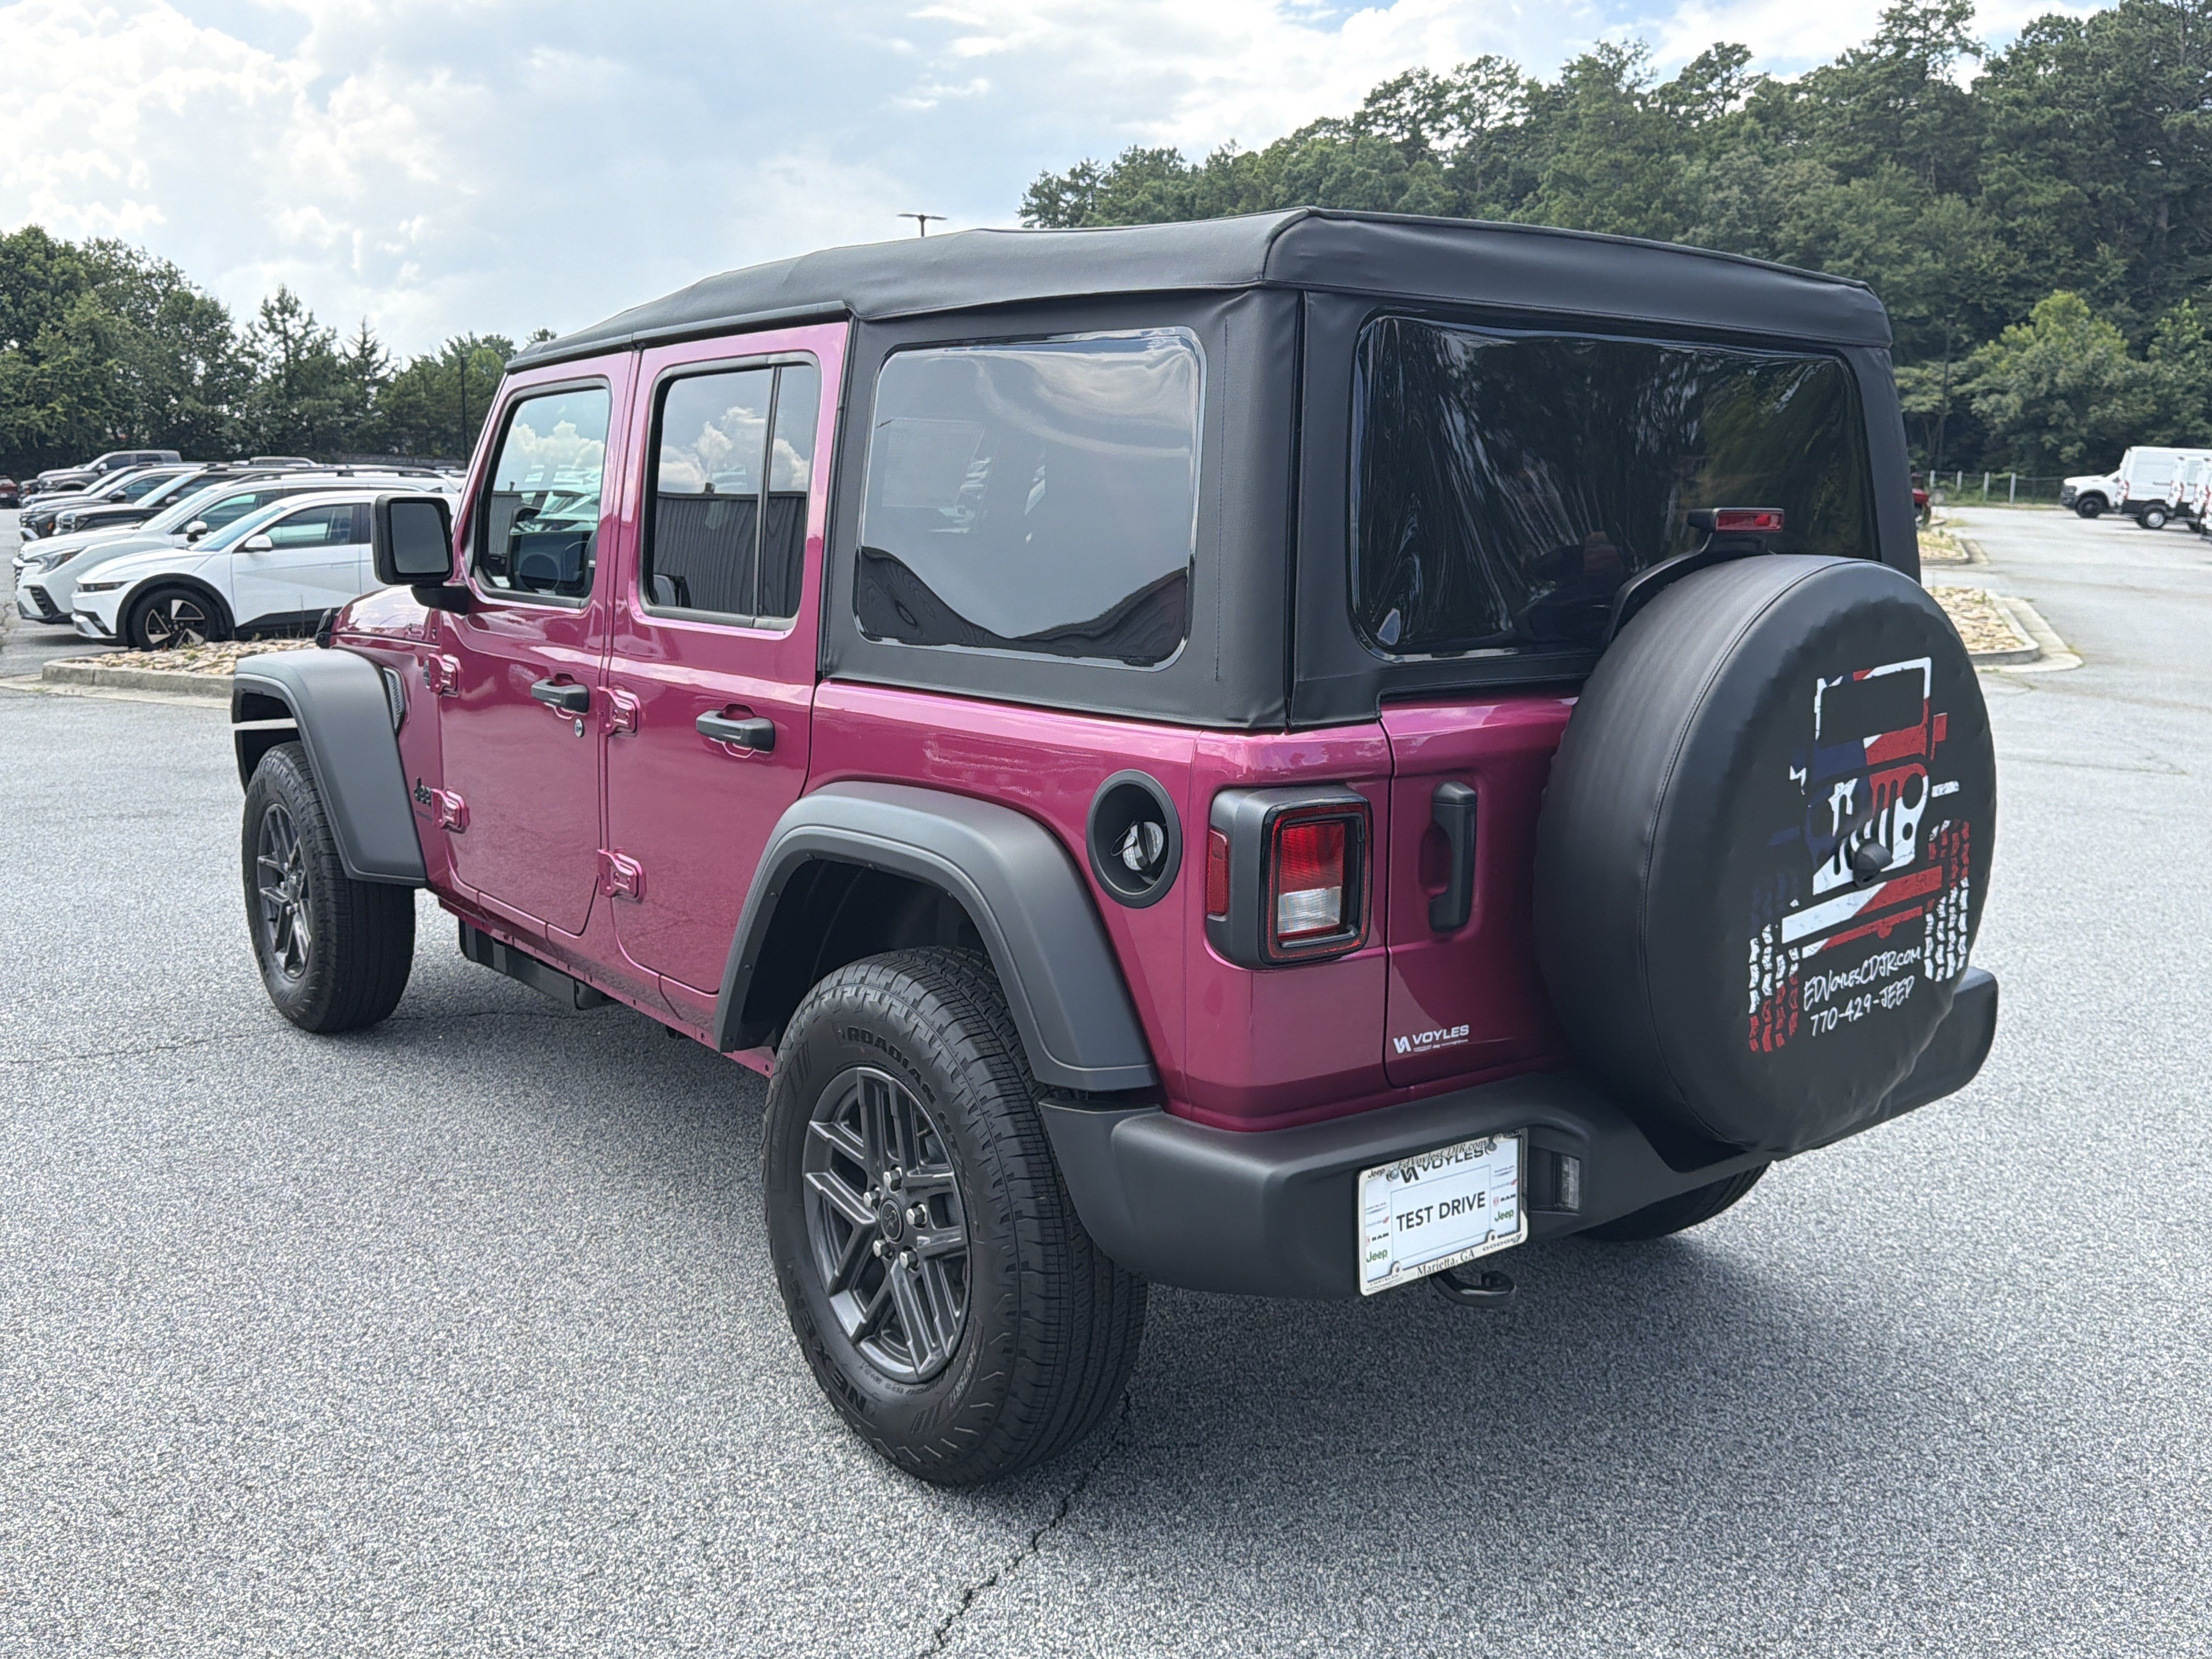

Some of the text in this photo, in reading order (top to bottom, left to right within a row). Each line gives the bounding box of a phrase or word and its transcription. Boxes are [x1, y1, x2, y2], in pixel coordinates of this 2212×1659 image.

[1810, 975, 1915, 1037] 770-429-JEEP
[1412, 1024, 1469, 1045] VOYLES
[1368, 1168, 1385, 1178] Jeep
[1396, 1191, 1486, 1232] TEST DRIVE
[1494, 1209, 1514, 1222] Jeep
[1366, 1249, 1388, 1263] Jeep
[1417, 1249, 1475, 1278] Marietta, GA
